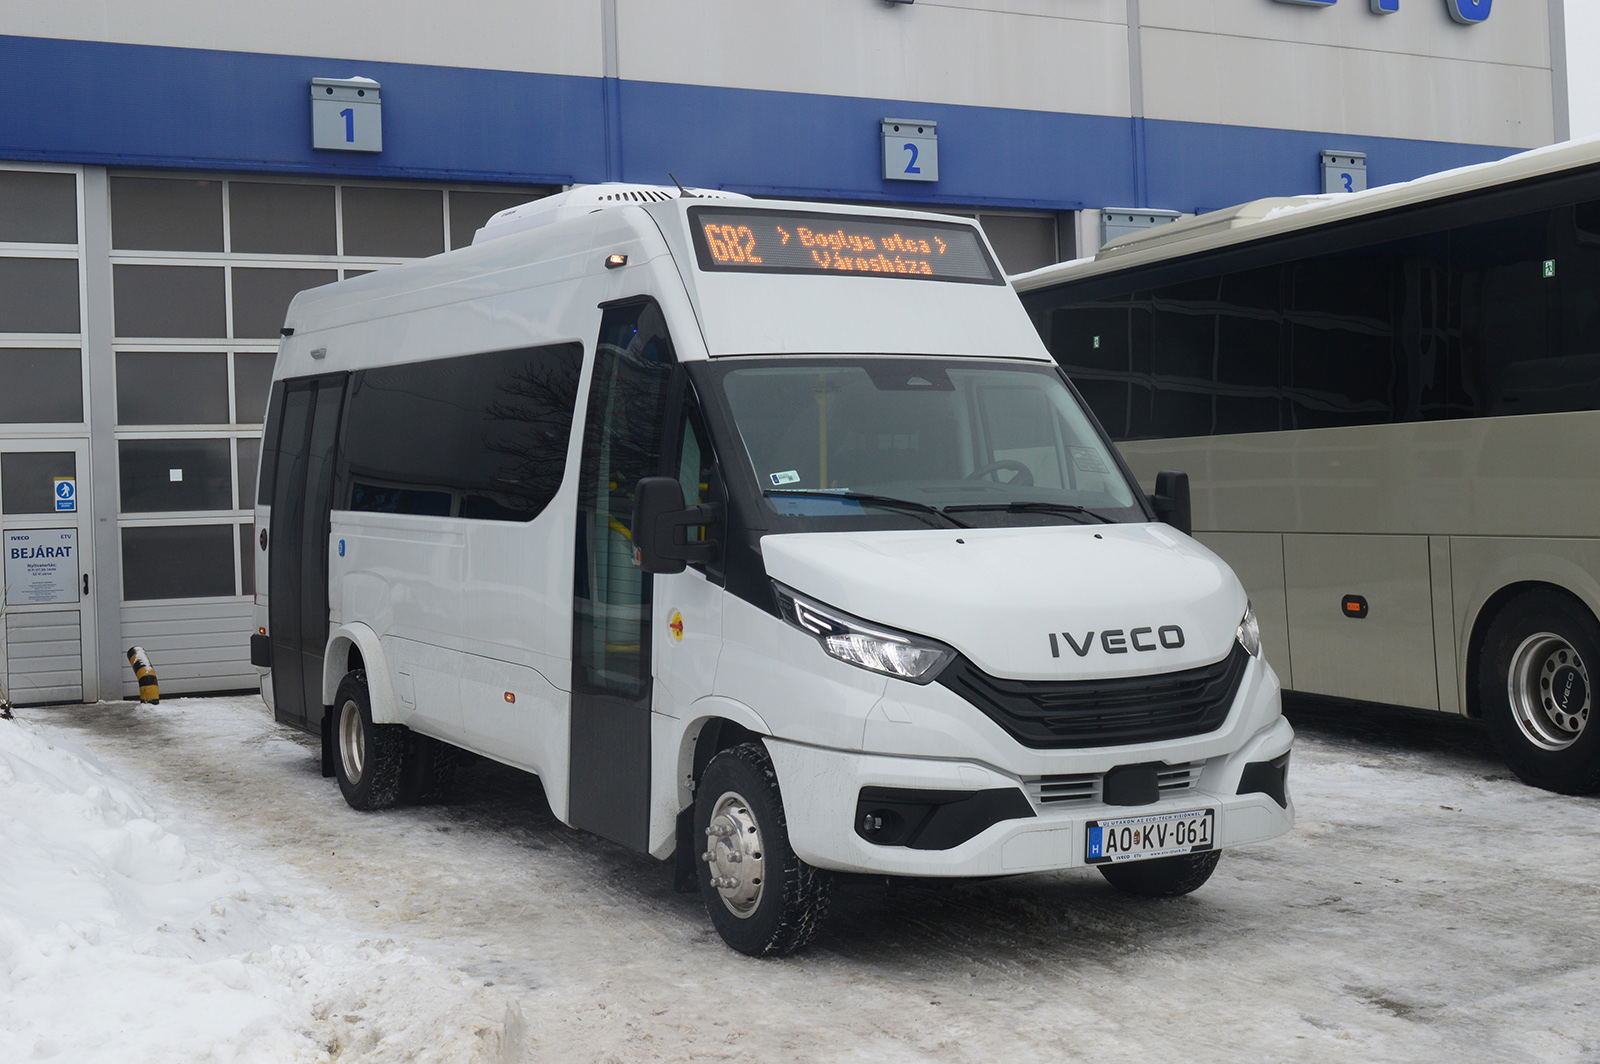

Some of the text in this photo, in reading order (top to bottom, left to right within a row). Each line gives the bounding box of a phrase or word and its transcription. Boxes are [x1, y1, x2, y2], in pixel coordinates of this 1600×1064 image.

[339, 108, 355, 143] 1
[903, 142, 921, 174] 2
[704, 223, 763, 264] 682
[796, 226, 932, 255] Boglya utca
[811, 249, 933, 275] Városháza
[11, 544, 72, 559] BEJÁRAT
[1048, 624, 1186, 658] IVECO
[1561, 671, 1575, 709] IVECO
[1091, 844, 1099, 855] H
